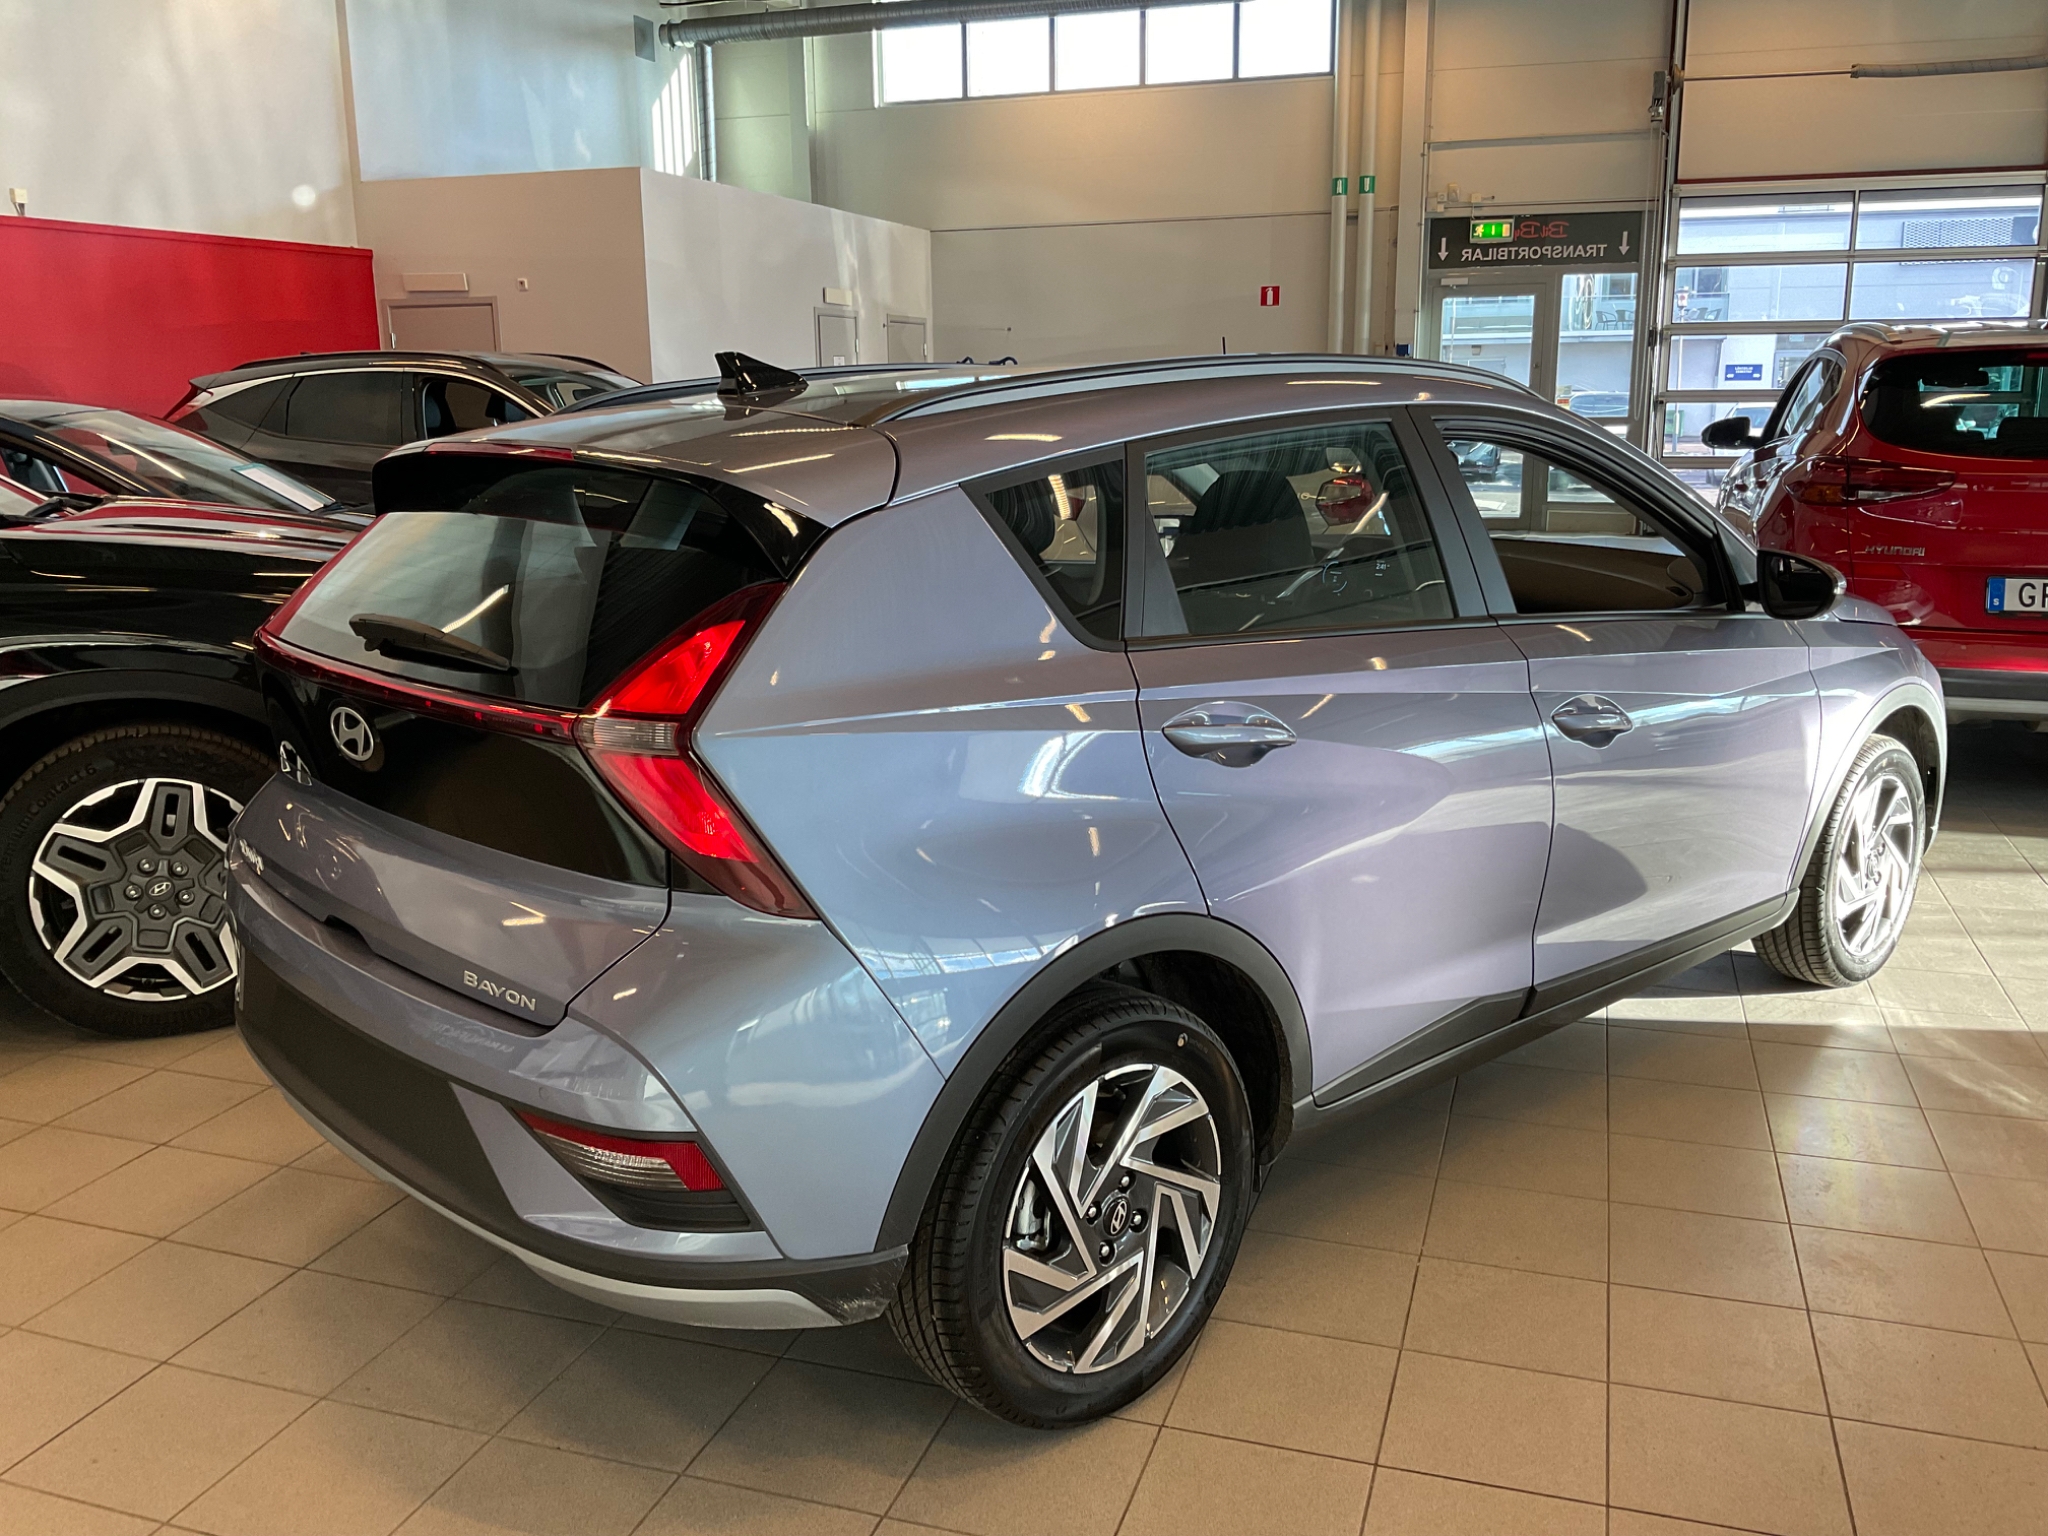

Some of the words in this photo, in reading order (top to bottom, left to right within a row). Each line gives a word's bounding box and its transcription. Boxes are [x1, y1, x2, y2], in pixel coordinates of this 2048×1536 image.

[1865, 545, 1926, 557] HYUNDAI
[1993, 598, 2000, 606] S
[463, 970, 536, 1011] BAYON
